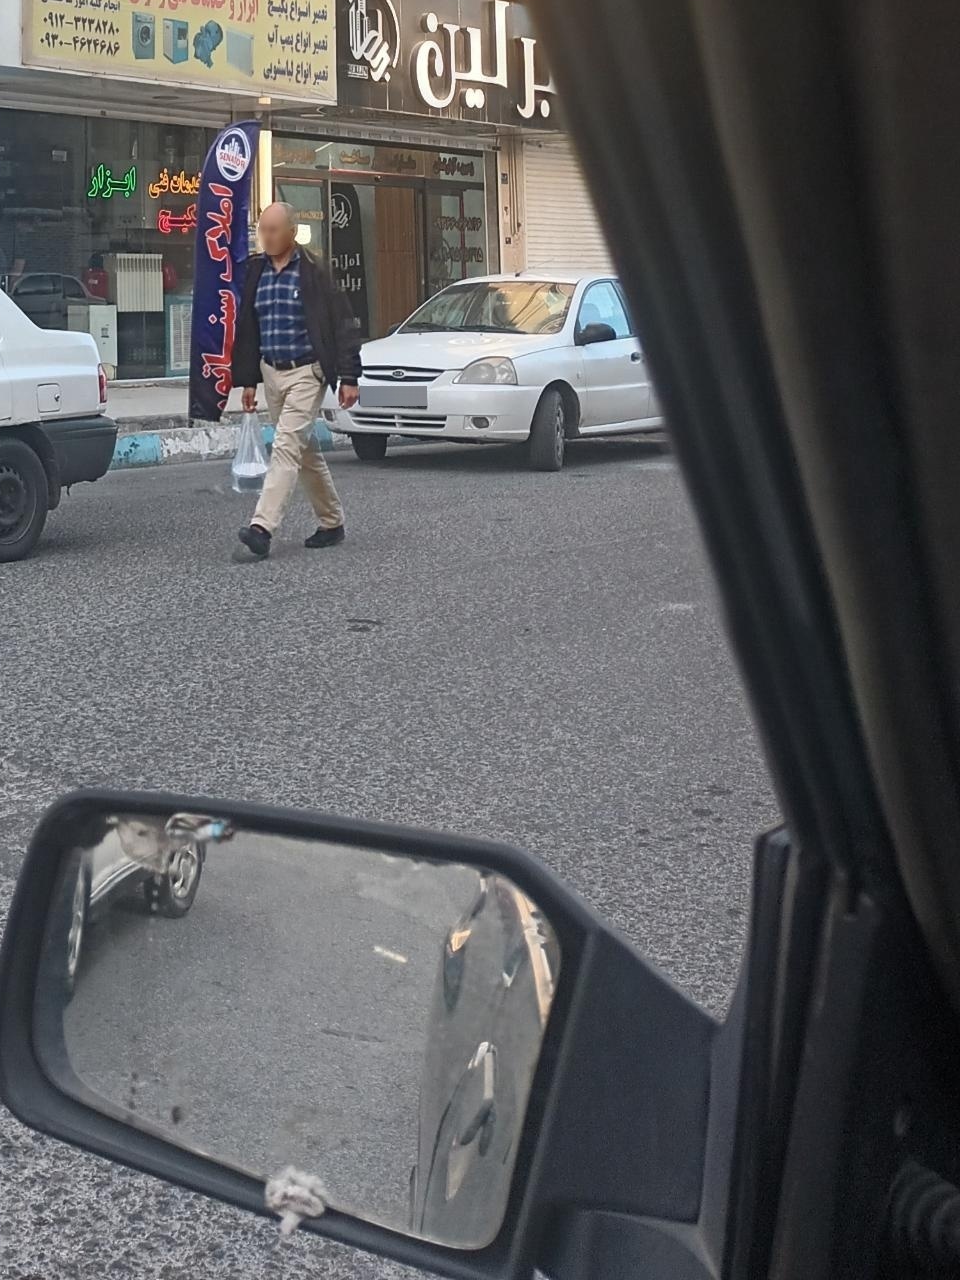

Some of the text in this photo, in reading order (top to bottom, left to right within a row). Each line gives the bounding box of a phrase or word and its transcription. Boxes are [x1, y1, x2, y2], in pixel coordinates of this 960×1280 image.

[103, 0, 121, 14] انجام
[311, 4, 328, 24] تعمیر
[267, 24, 279, 48] آب
[294, 30, 311, 54] انواع
[311, 34, 328, 55] تعمیر
[295, 61, 312, 85] انواع
[312, 65, 329, 86] تعمیر
[88, 163, 136, 198] ابزار
[148, 167, 169, 199] فنی
[158, 203, 197, 234] کیج
[205, 182, 234, 282] املاک
